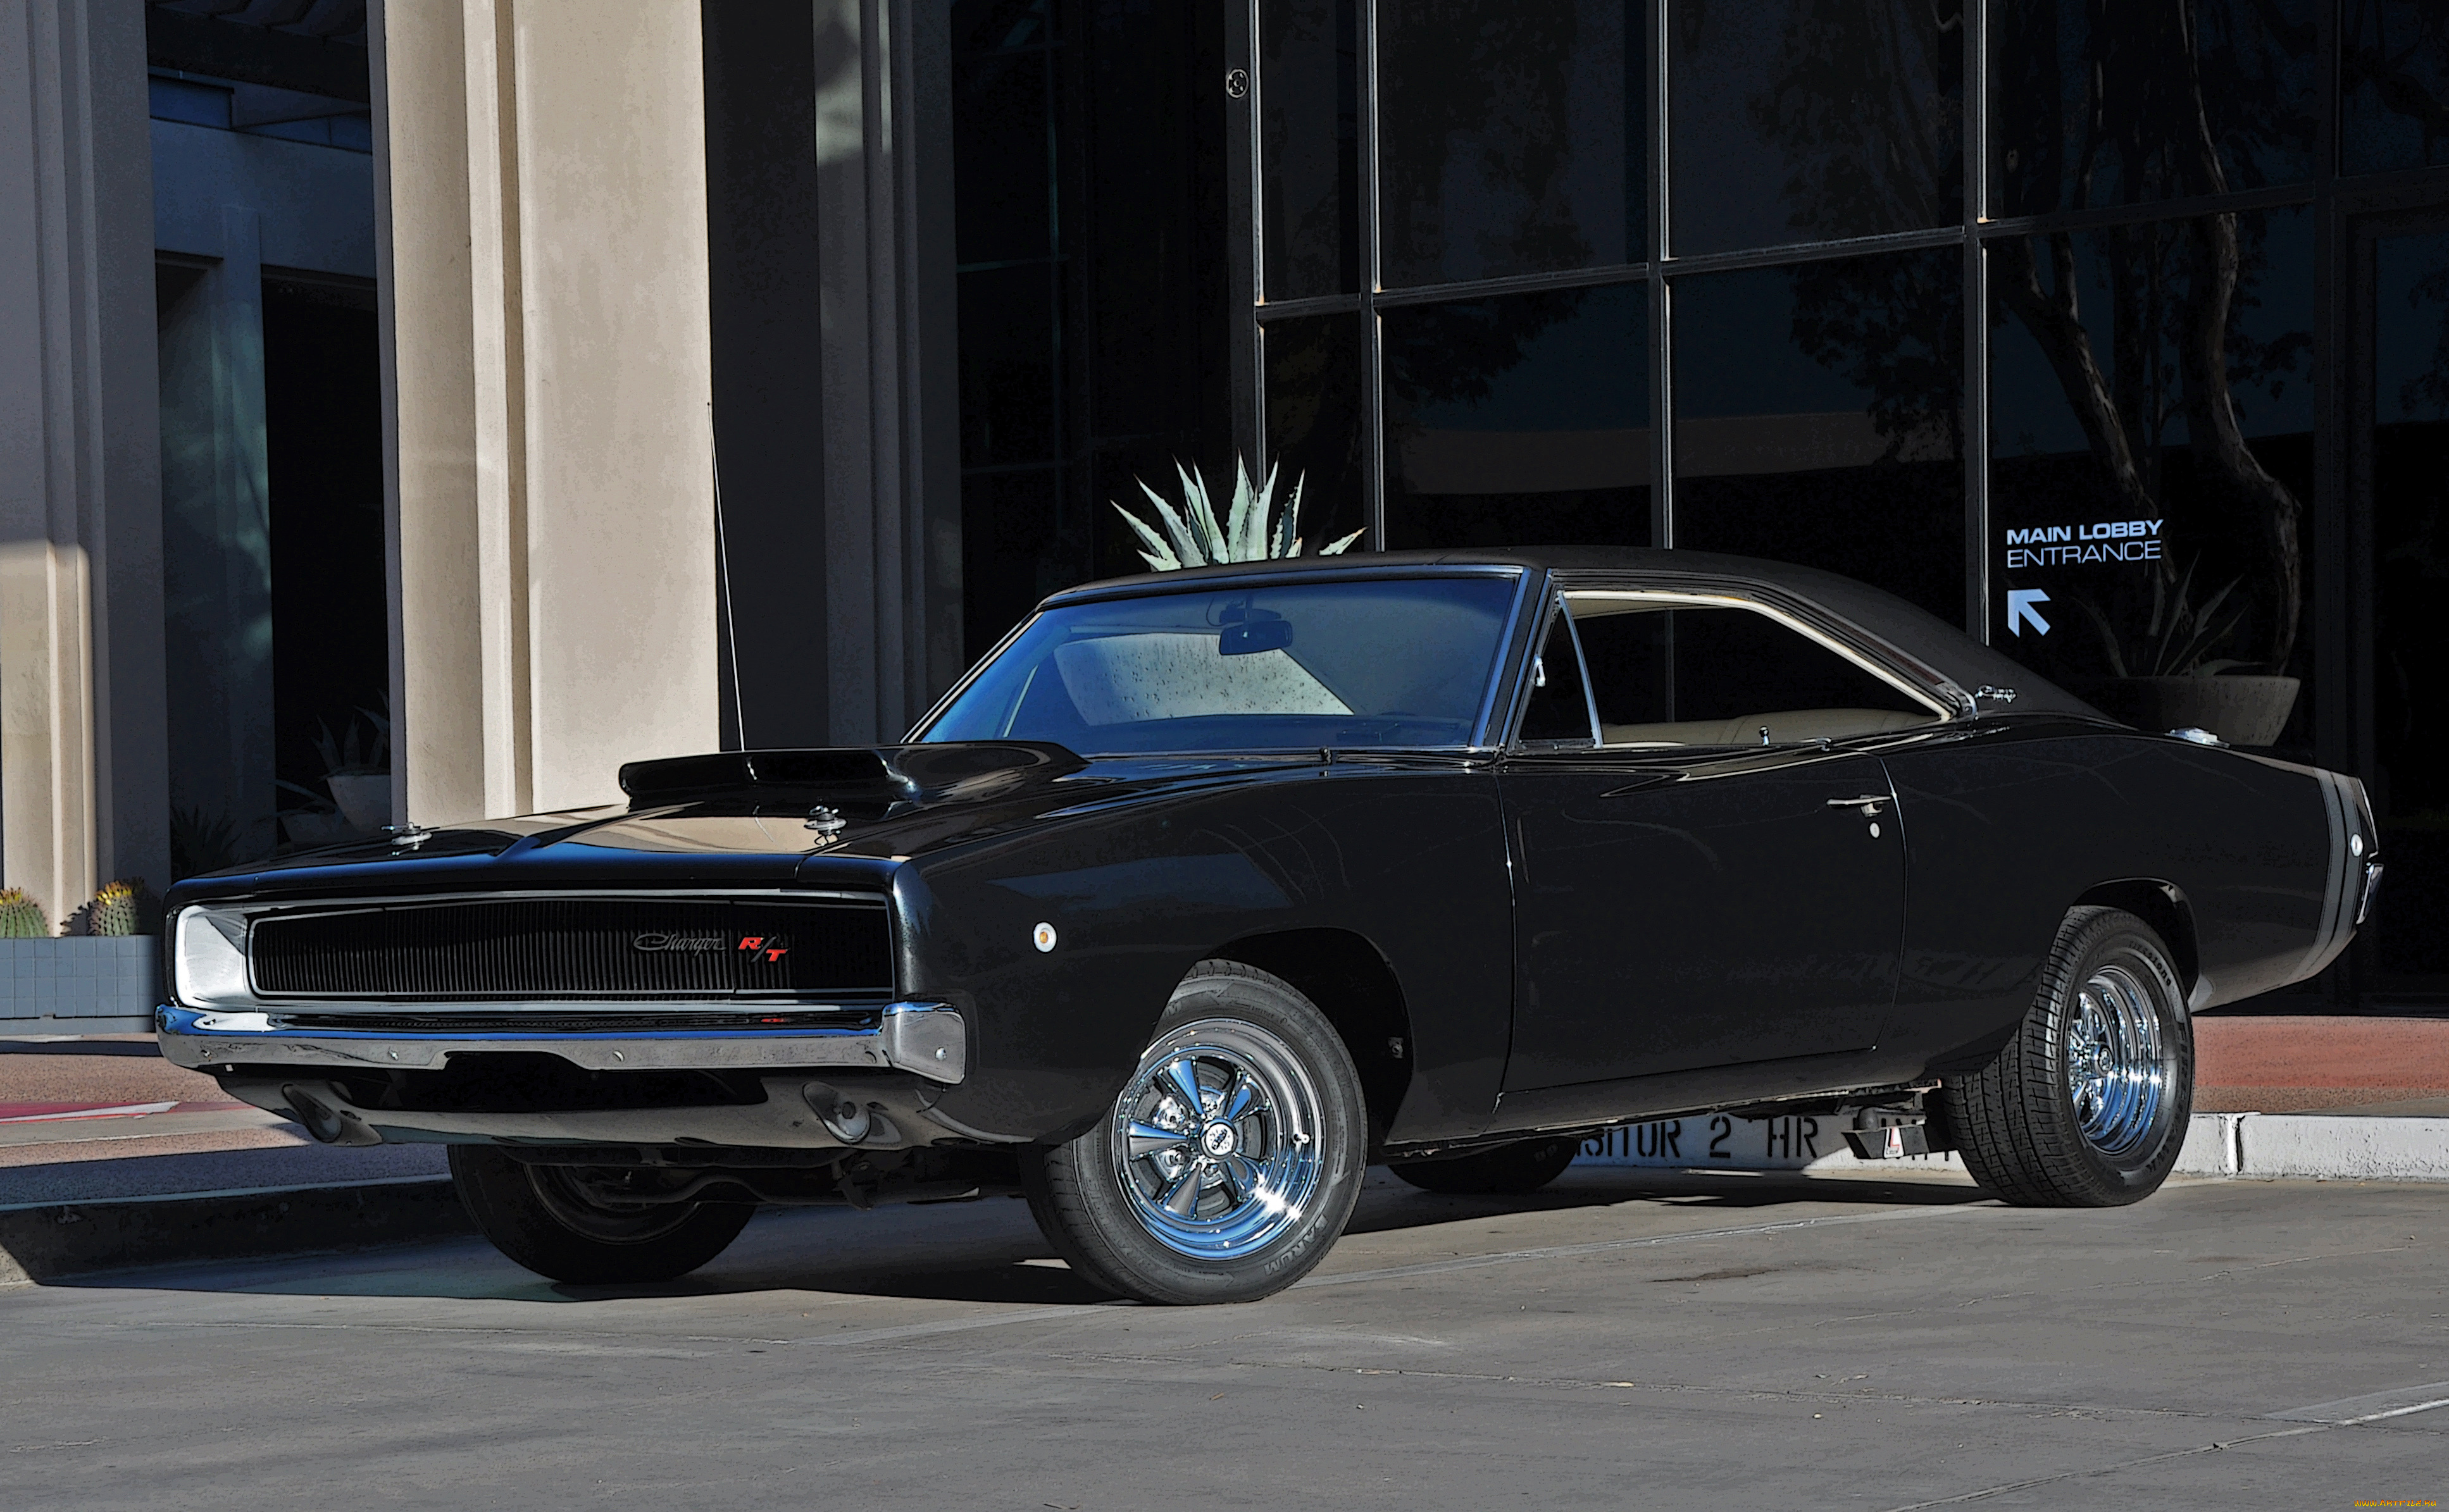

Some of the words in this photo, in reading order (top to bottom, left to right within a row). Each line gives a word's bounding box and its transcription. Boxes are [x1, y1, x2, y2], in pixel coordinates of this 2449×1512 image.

[2007, 525, 2071, 545] MAIN
[2079, 519, 2164, 540] LOBBY
[2007, 540, 2162, 568] ENTRANCE
[633, 933, 726, 957] Charger
[738, 936, 790, 963] R/T
[1709, 1116, 1731, 1158] 2
[1767, 1117, 1818, 1158] HR
[1262, 1213, 1329, 1275] BARUM
